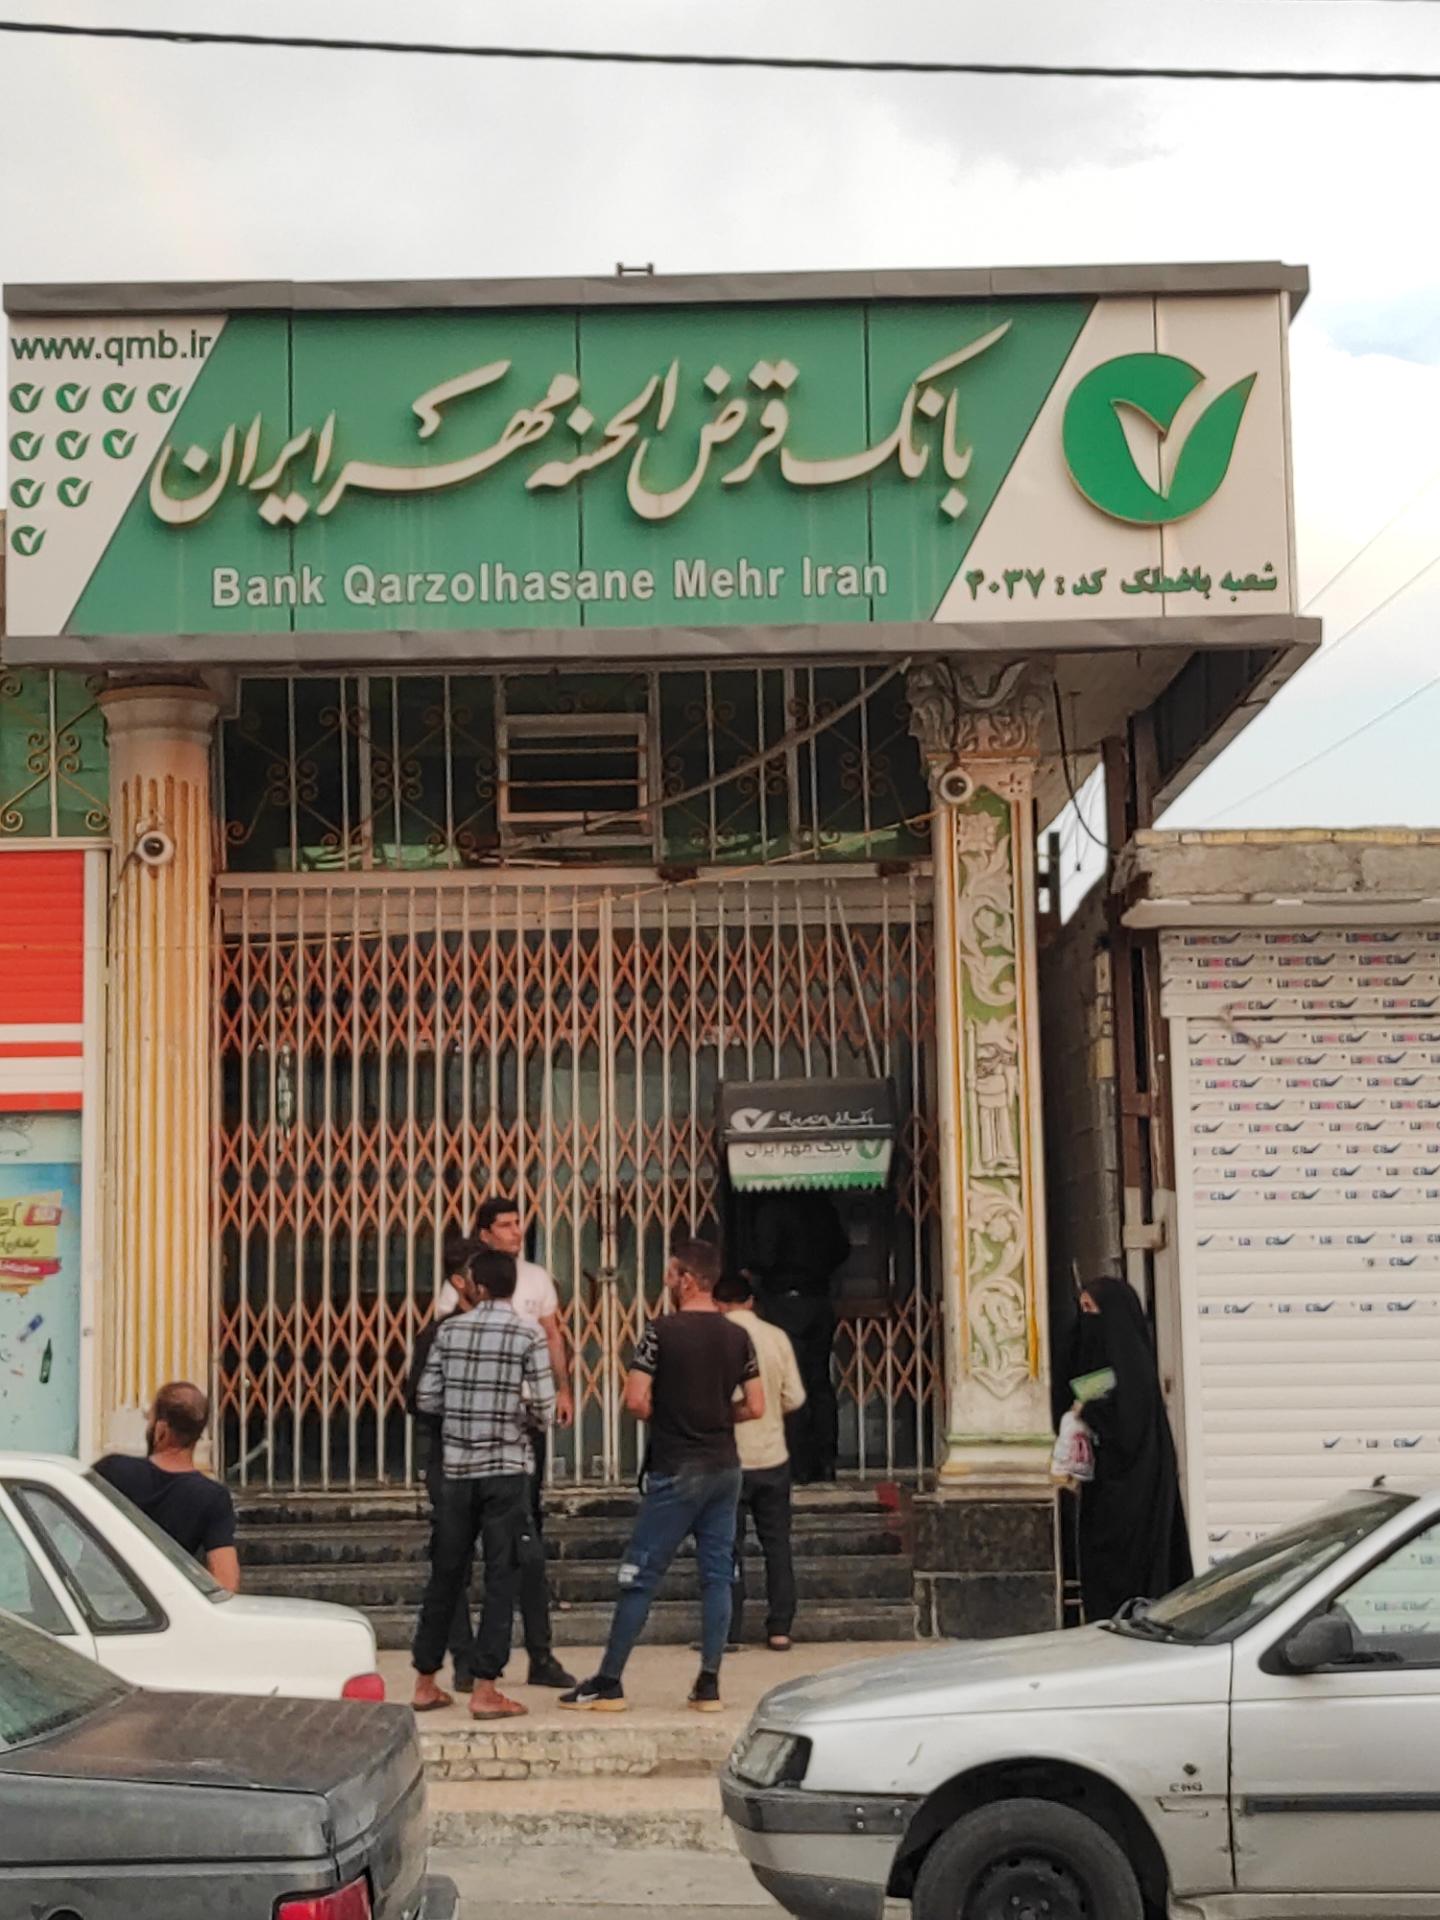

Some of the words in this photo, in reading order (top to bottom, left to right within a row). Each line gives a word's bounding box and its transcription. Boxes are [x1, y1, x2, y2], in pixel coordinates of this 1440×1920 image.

[10, 329, 212, 366] www.qmb.ir
[149, 409, 336, 527] ایران
[315, 358, 580, 517] مهر
[525, 358, 680, 490] الحسنه
[627, 359, 800, 520] قرض
[781, 318, 1013, 519] بانک
[213, 566, 325, 607] Bank
[343, 562, 655, 606] Qarzolhasane
[673, 557, 785, 600] Mehr
[802, 556, 888, 597] Iran
[1219, 561, 1278, 602] شعبه
